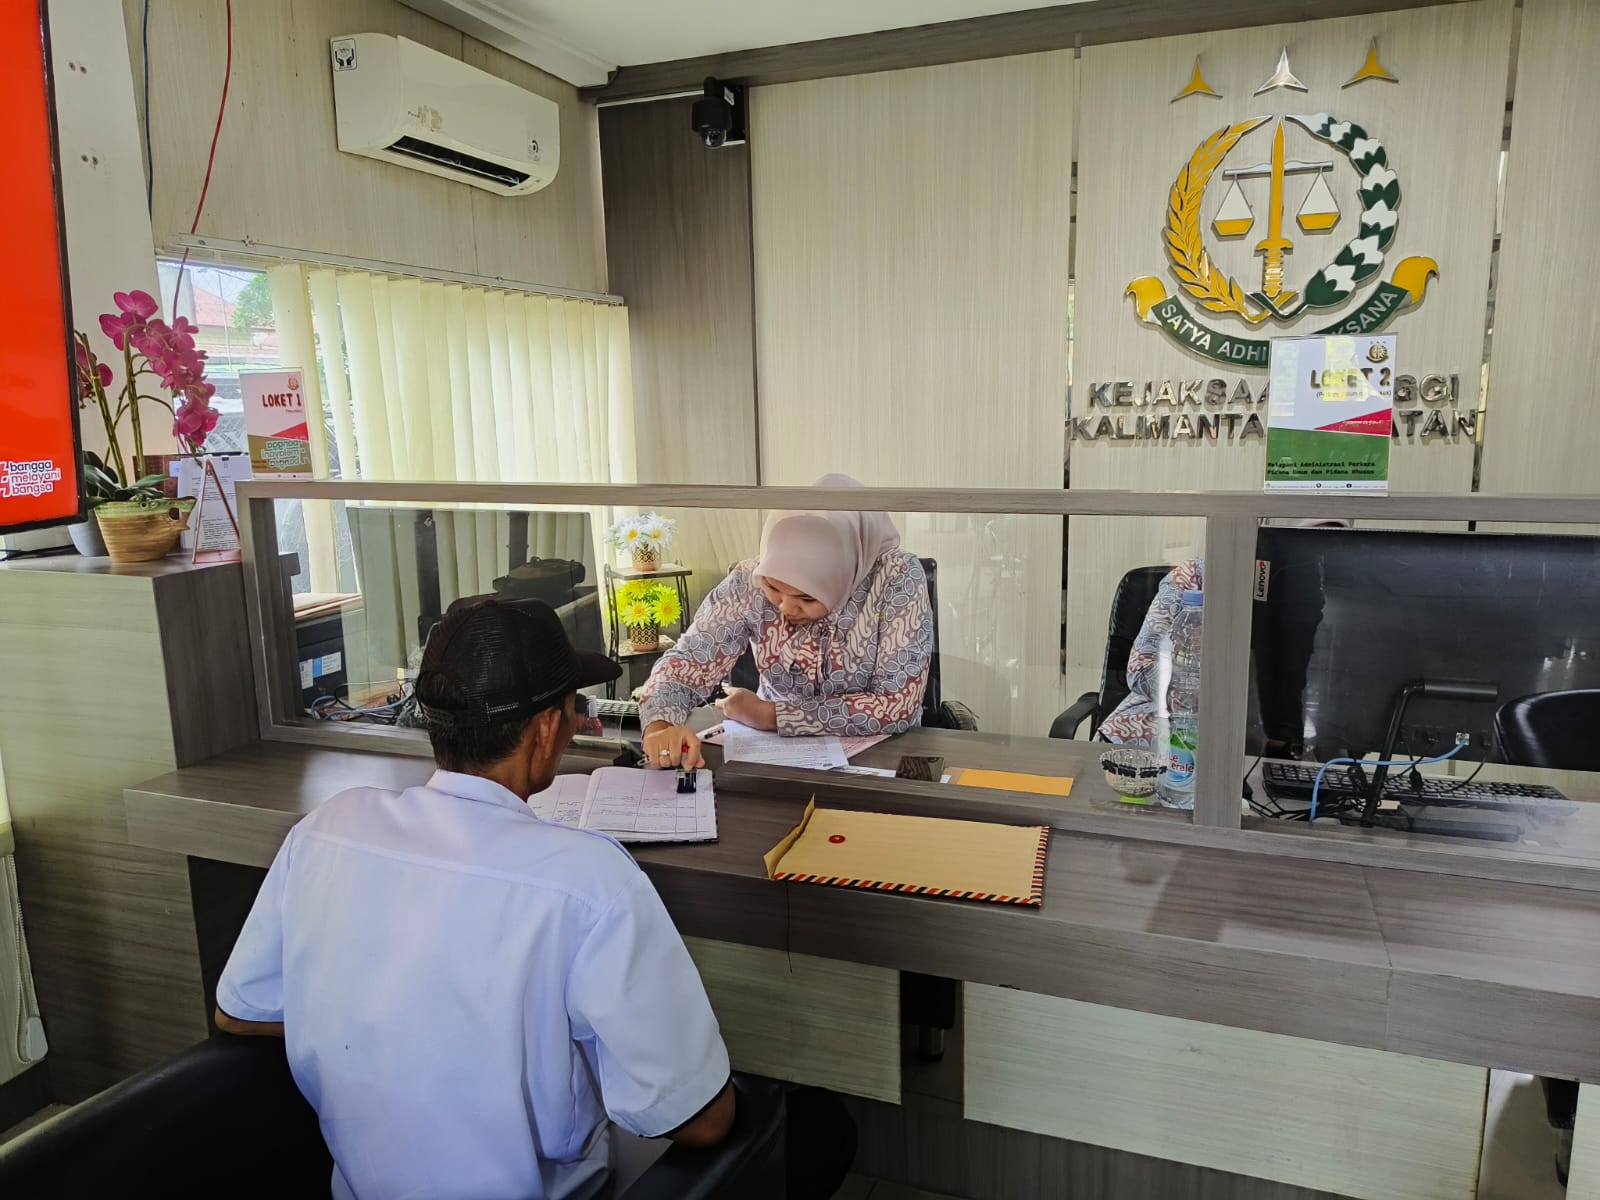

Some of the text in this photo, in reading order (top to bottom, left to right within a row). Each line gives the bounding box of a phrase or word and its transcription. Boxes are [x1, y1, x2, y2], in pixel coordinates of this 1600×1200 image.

[1161, 292, 1398, 361] SATYA ADHI SANA
[1379, 366, 1391, 387] 2
[262, 392, 302, 408] LOKET 1
[10, 461, 52, 473] bangga
[11, 469, 61, 483] melayani
[12, 483, 52, 495] bangsa
